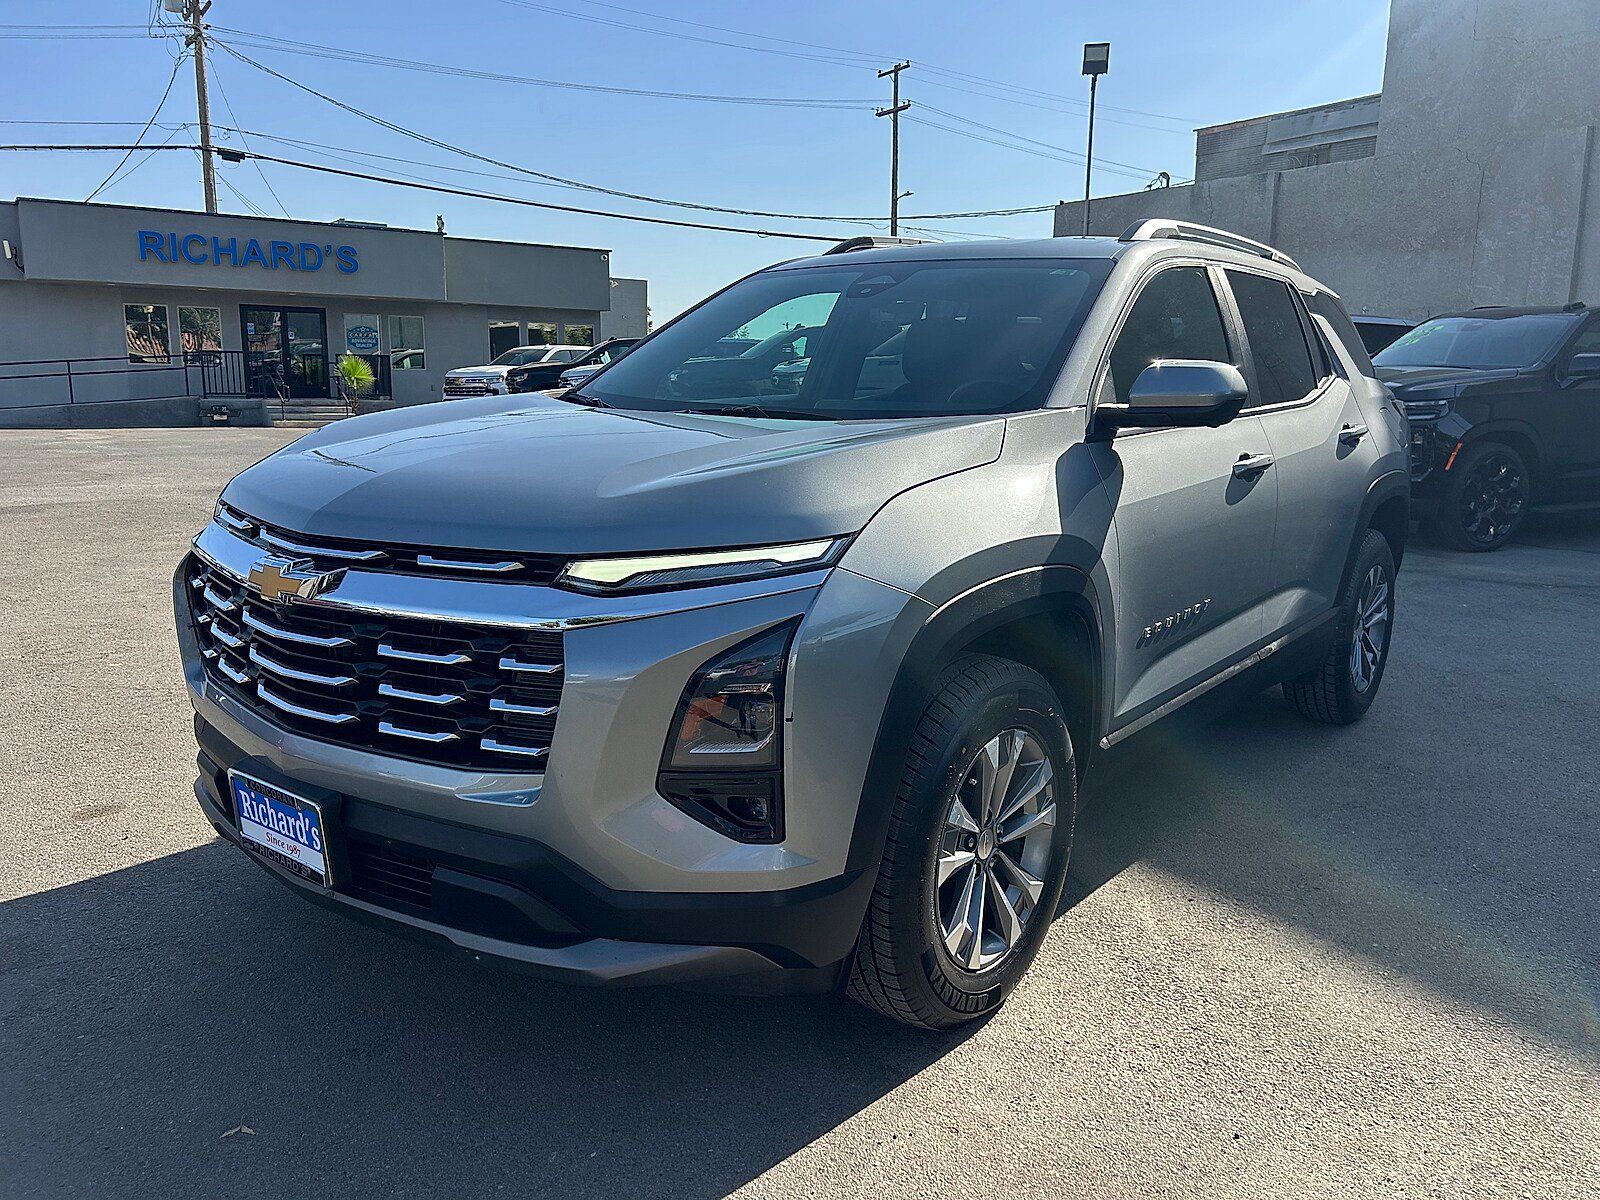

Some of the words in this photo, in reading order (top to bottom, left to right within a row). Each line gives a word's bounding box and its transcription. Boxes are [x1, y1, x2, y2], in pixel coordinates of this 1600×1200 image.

[137, 229, 360, 275] RICHARD'S
[250, 780, 294, 806] CORCORAN
[238, 789, 322, 851] Richard's
[265, 831, 285, 849] Since
[286, 843, 301, 858] 1987
[258, 845, 309, 876] RICHARD'S
